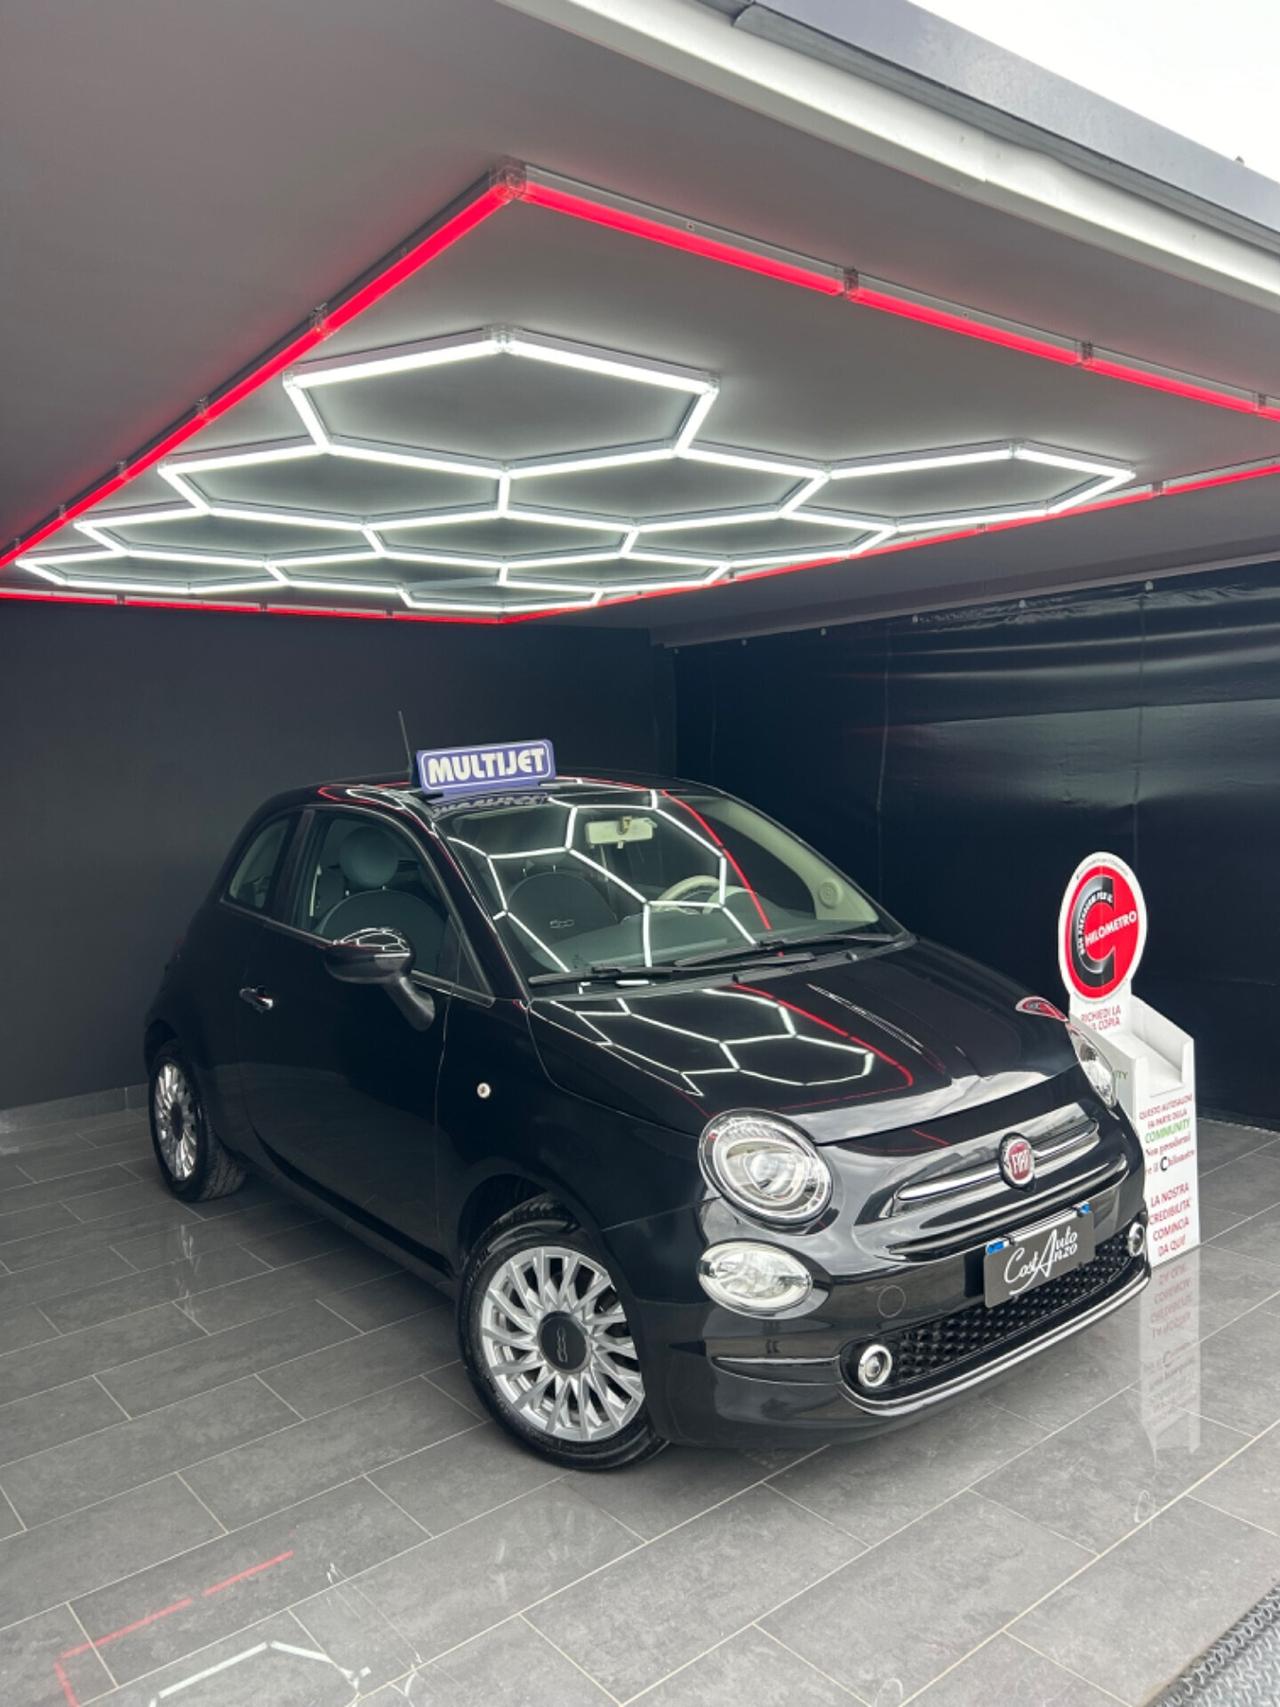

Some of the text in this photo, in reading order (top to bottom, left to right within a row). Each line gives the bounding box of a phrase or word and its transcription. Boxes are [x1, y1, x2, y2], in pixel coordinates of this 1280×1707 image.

[427, 748, 545, 784] MULTIJET
[1112, 1005, 1121, 1015] LA
[1145, 1118, 1190, 1143] COMMUNITY
[1151, 1182, 1189, 1207] LA NOSTRA
[1153, 1216, 1189, 1241] COMINCIA
[1158, 1242, 1169, 1257] DA
